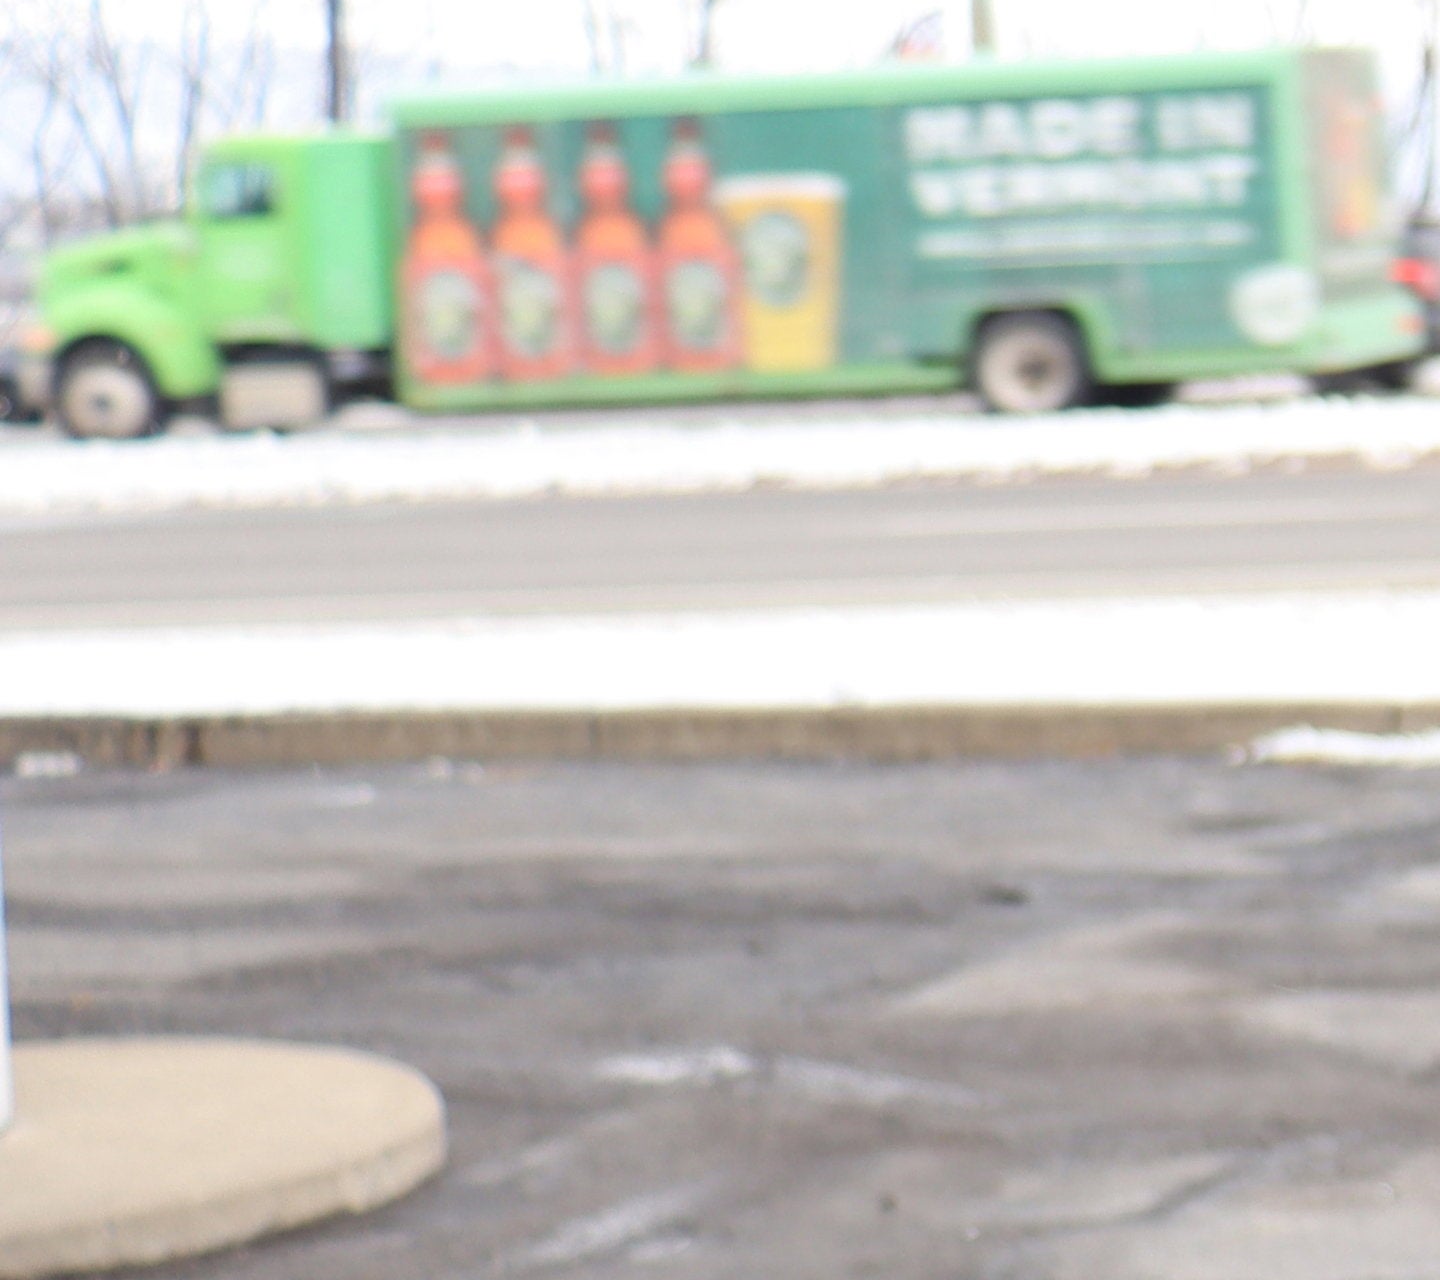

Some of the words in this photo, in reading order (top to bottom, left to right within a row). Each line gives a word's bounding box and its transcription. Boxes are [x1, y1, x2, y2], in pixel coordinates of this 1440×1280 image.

[904, 96, 1142, 163] MADE
[1155, 93, 1254, 150] IN
[910, 154, 1257, 216] VERMONT
